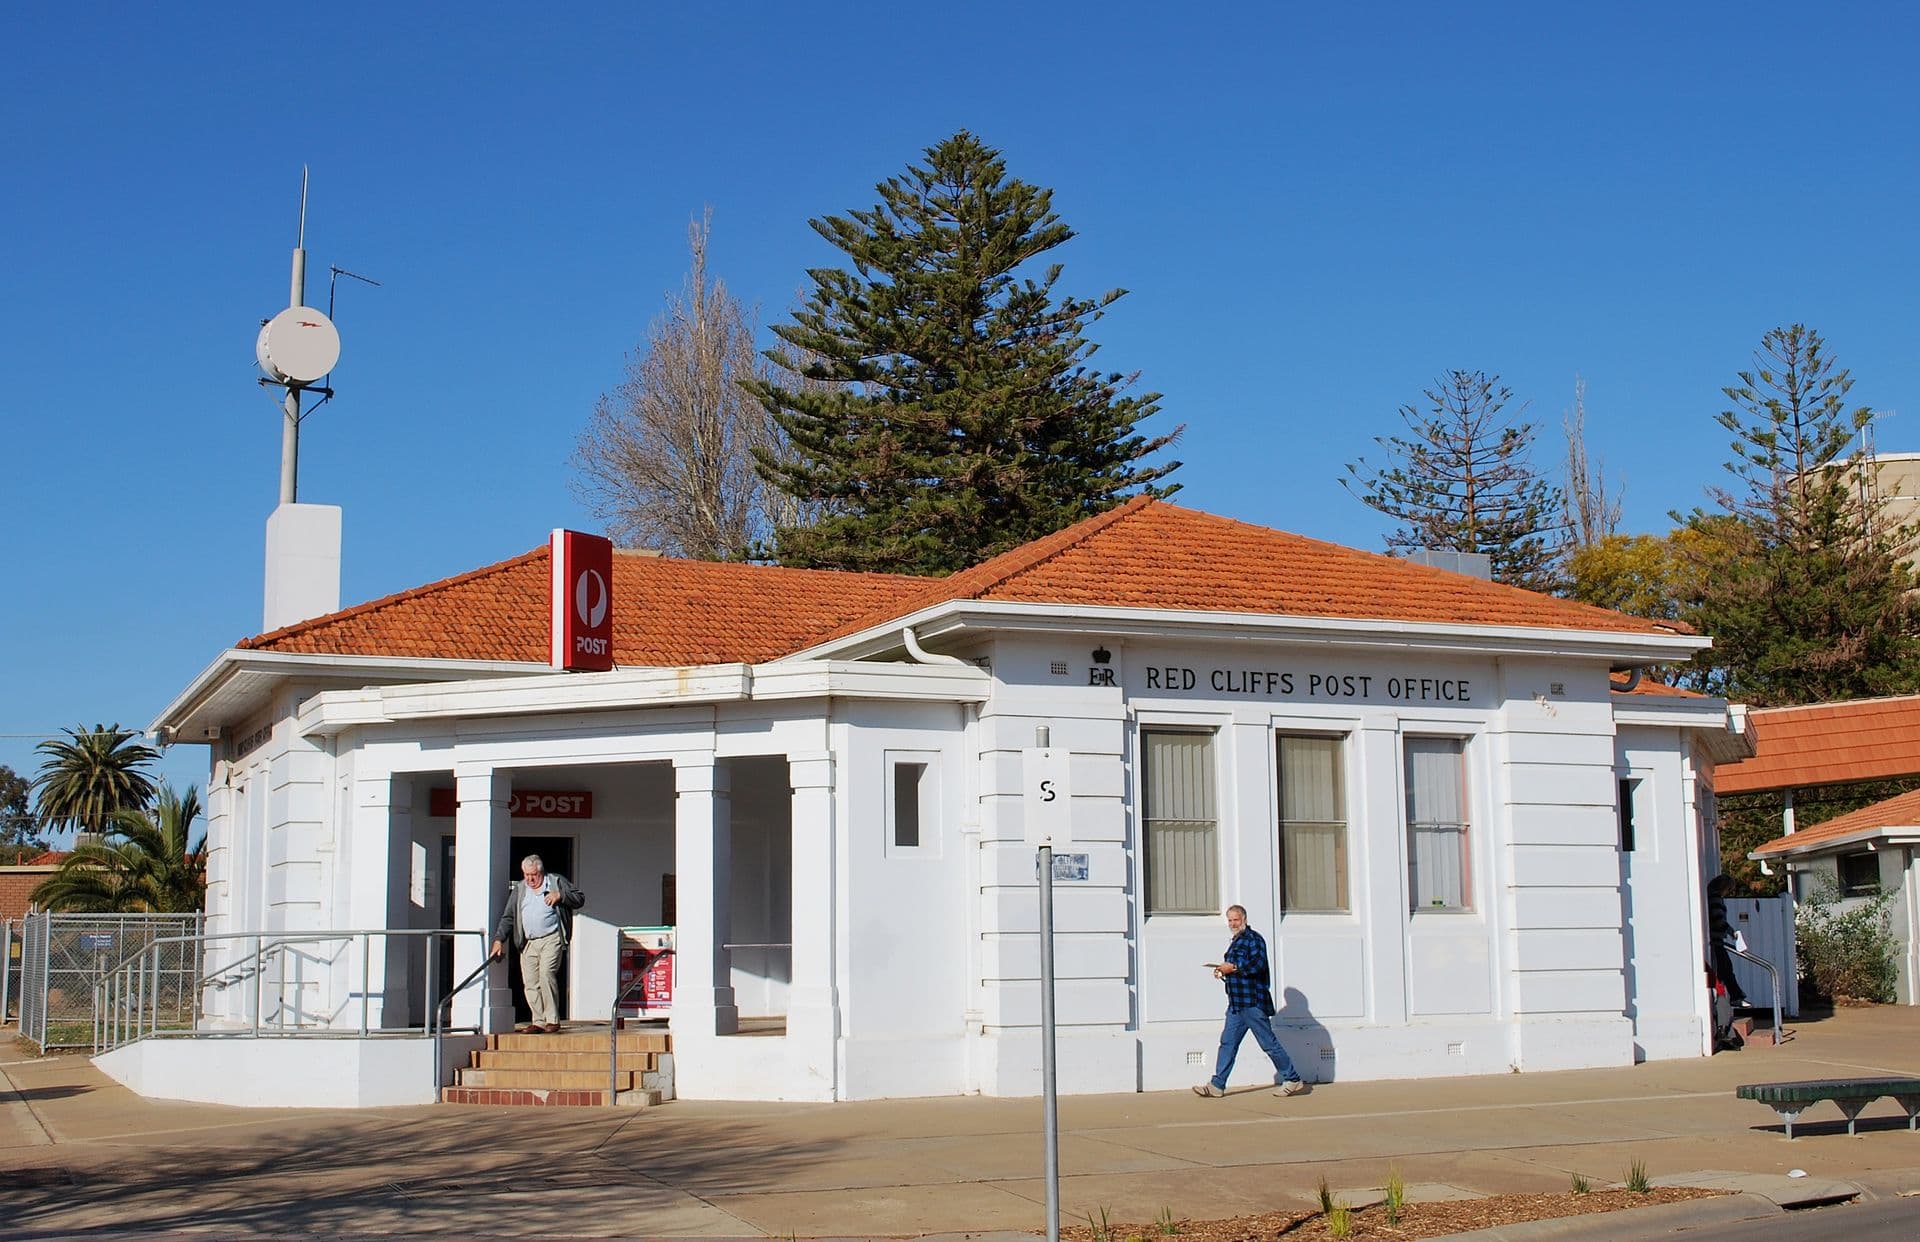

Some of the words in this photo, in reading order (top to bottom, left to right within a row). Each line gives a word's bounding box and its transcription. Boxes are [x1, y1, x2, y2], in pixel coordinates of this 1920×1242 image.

[576, 636, 608, 655] POST
[1146, 667, 1196, 690] RED
[1211, 670, 1294, 694] CLIFFS
[1309, 674, 1372, 697] POST
[1388, 678, 1471, 701] OFFICE
[526, 795, 585, 813] POST
